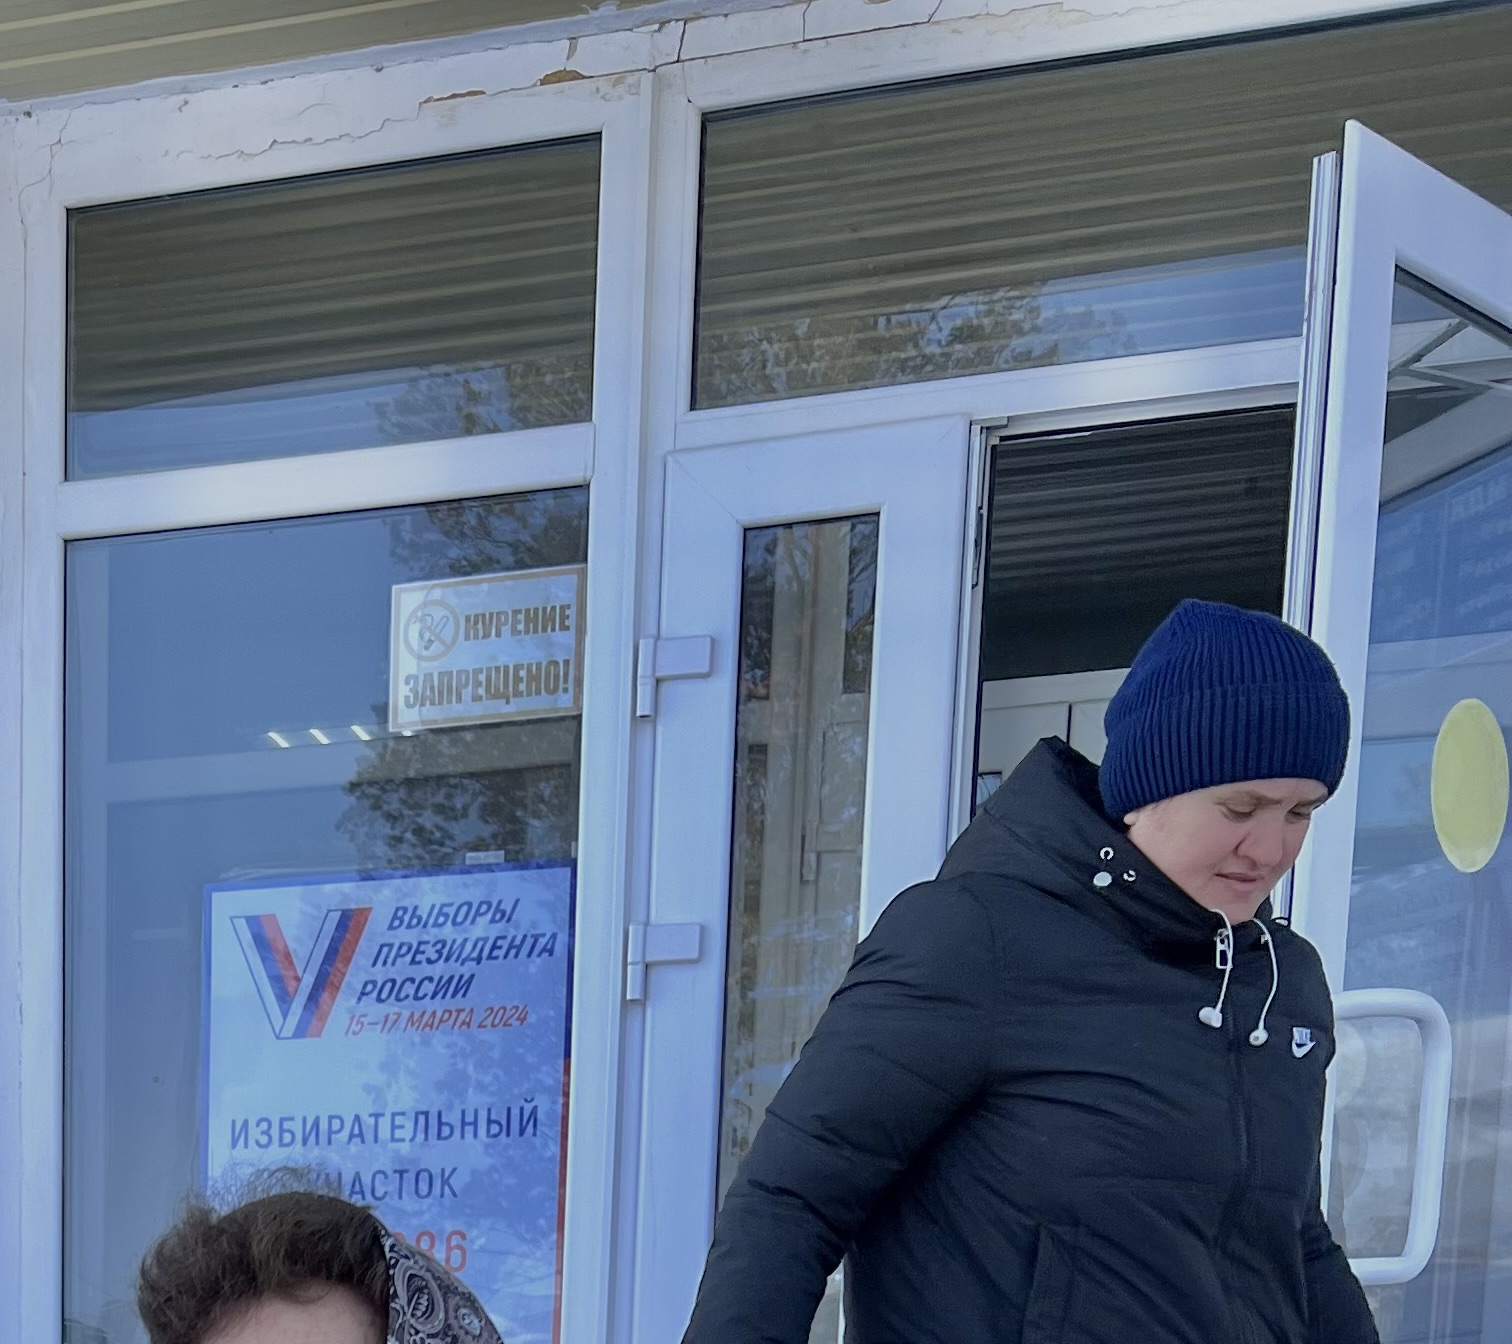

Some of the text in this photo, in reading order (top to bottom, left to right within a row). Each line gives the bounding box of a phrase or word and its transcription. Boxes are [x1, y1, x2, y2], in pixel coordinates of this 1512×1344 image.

[464, 604, 571, 641] КУРЕНИЕ
[404, 659, 571, 709] ЗАПРЕЩЕНО!
[387, 898, 520, 931] ВЫБОРЫ
[371, 932, 558, 968] ПРЕЗИДЕНТА
[356, 974, 475, 1004] РОССИИ
[403, 1007, 474, 1033] МАРТА
[477, 1004, 529, 1029] 2024
[230, 1097, 539, 1150] ИЗБИРАТЕЛЬНЫЙ
[310, 1166, 459, 1202] АСТОК
